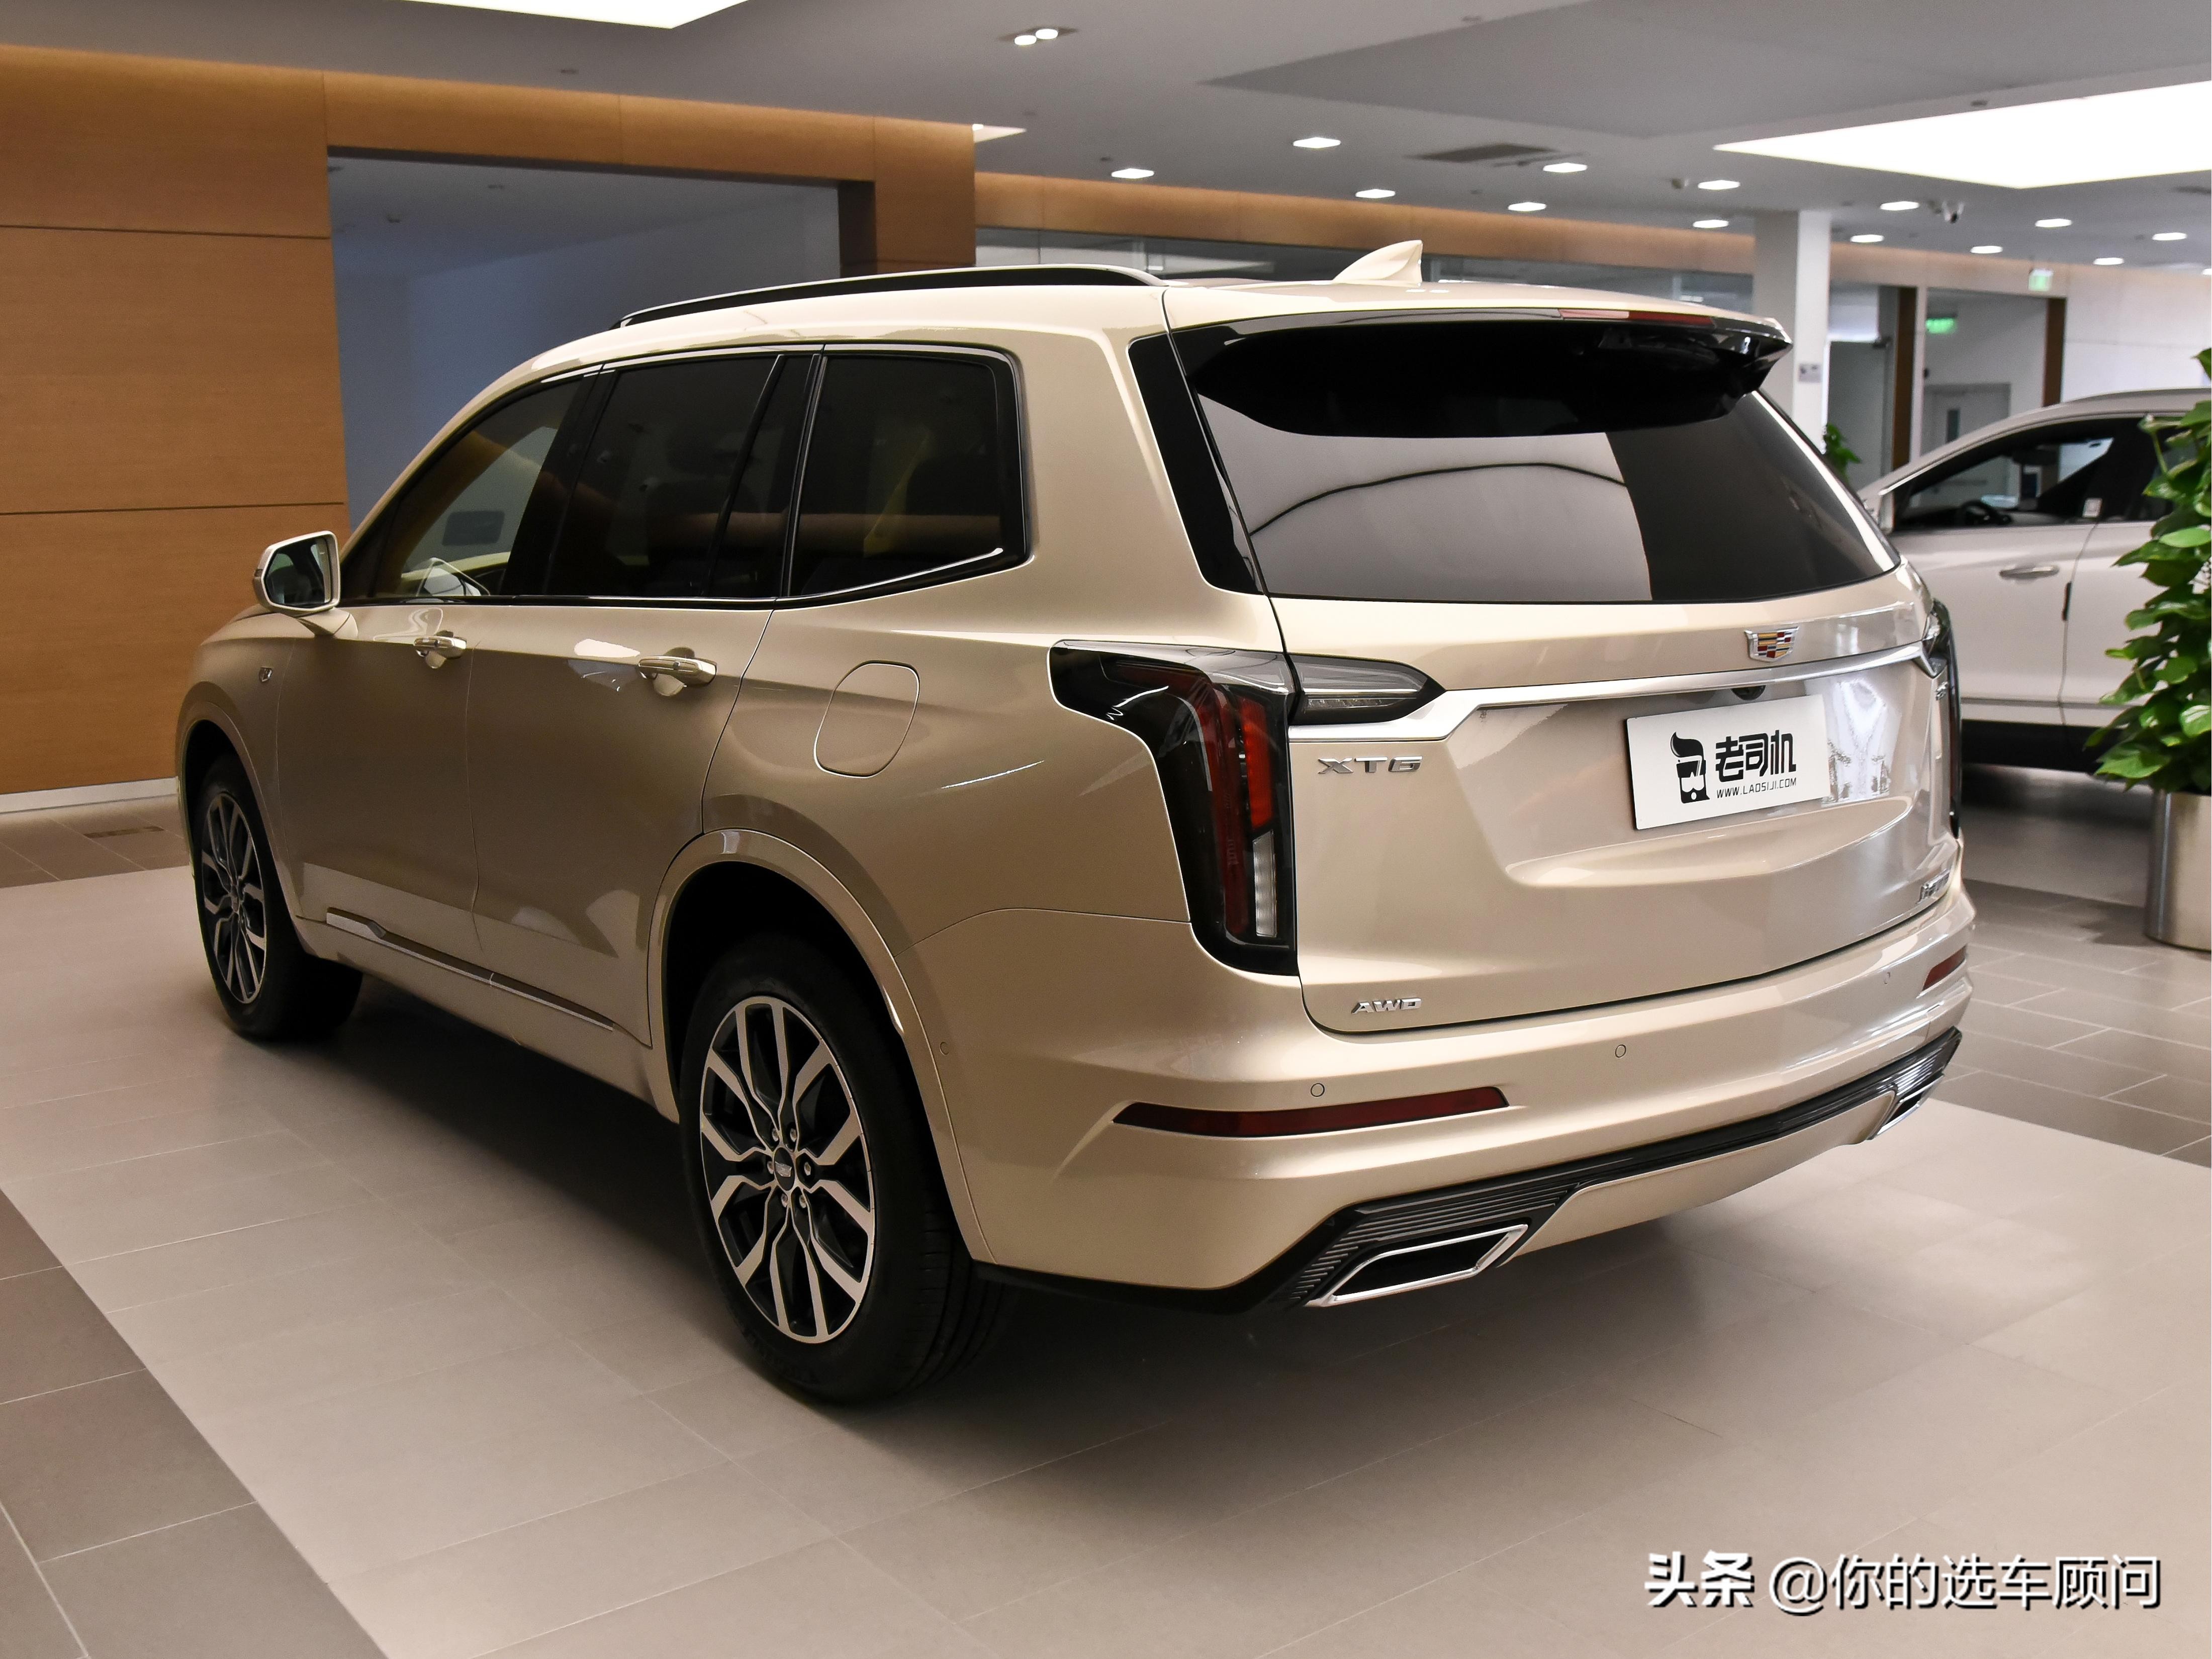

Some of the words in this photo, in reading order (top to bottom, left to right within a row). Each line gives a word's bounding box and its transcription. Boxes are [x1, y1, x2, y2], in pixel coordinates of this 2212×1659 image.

[1318, 756, 1423, 775] XT6
[1715, 729, 1796, 782] 老司机
[1716, 777, 1796, 798] WWW.LAOSIJI.COM
[1351, 997, 1423, 1015] AWD
